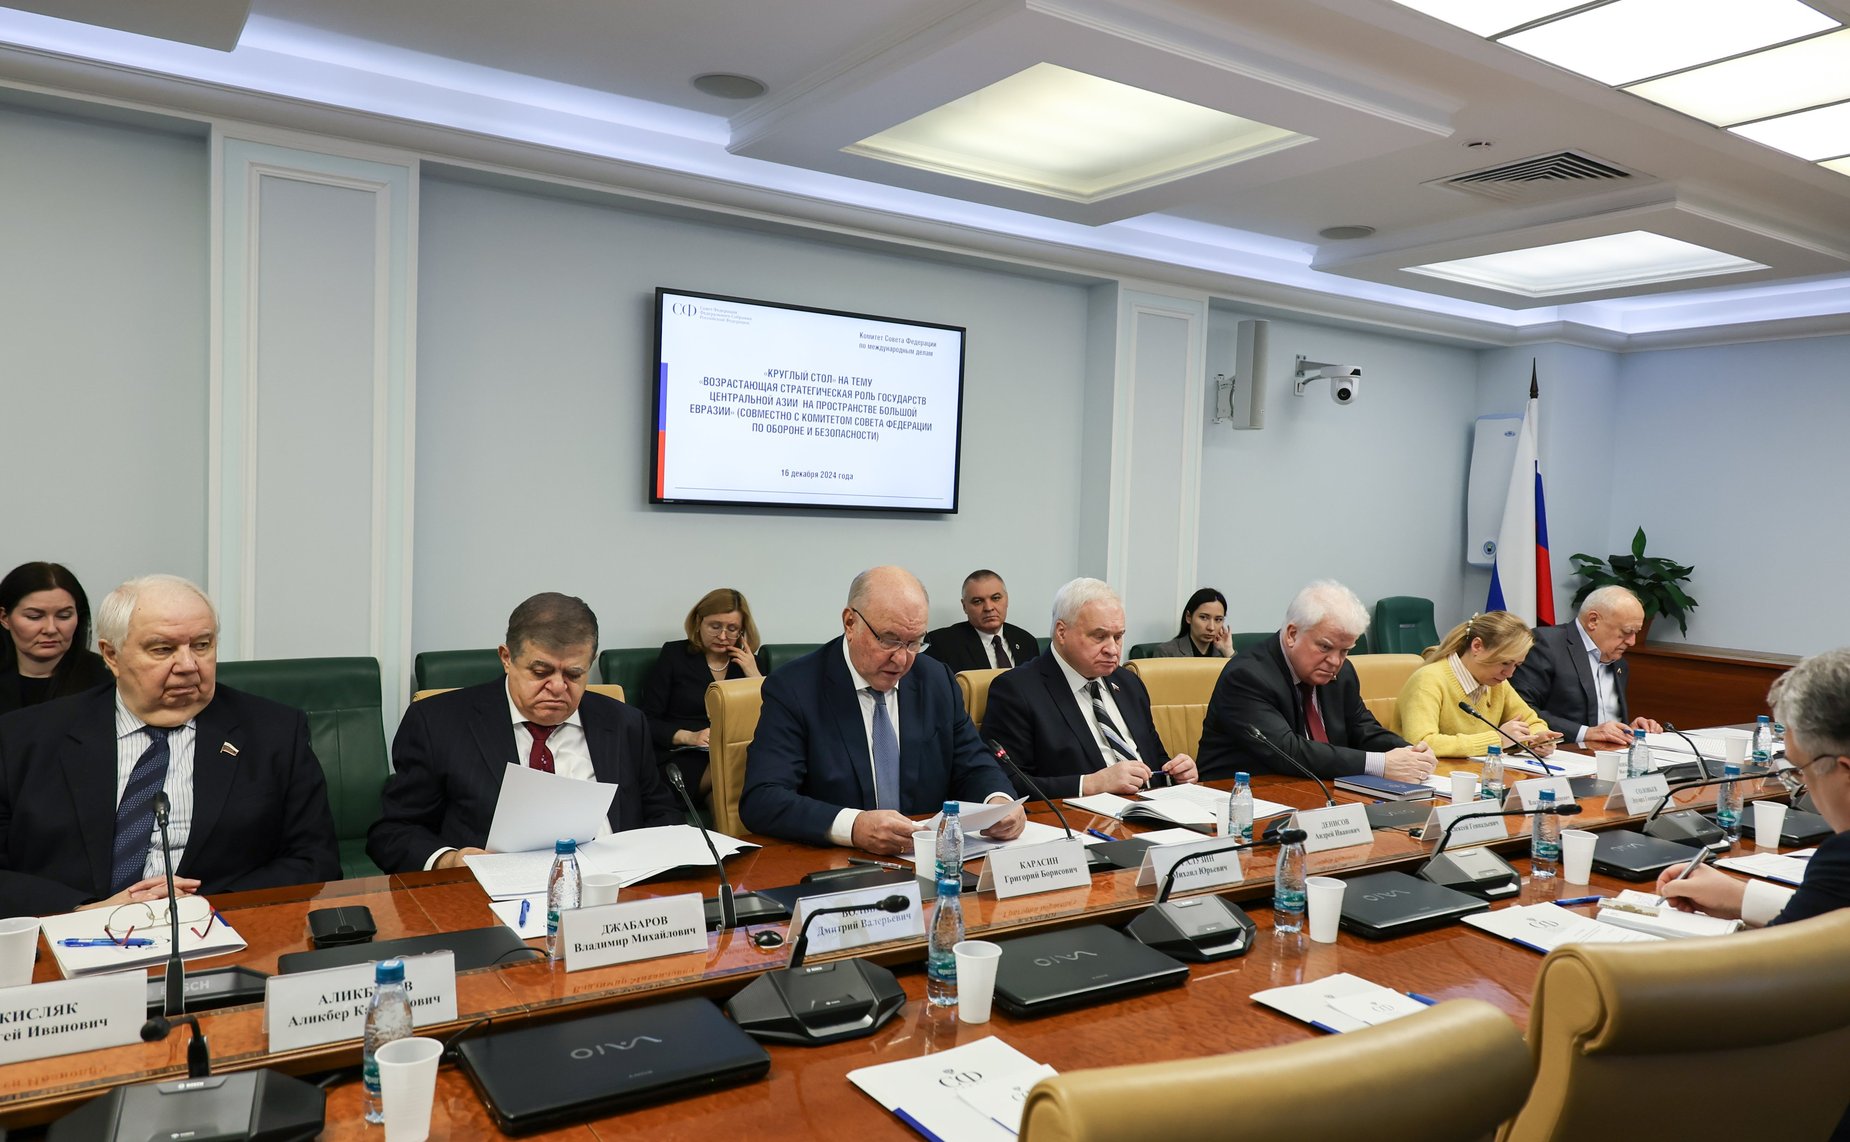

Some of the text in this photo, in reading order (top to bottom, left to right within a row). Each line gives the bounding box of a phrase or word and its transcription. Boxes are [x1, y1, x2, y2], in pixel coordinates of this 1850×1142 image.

[672, 302, 697, 317] СФ
[860, 332, 937, 348] Комитет Совета Федерации
[868, 344, 914, 354] международным
[838, 376, 849, 385] НА
[851, 376, 872, 388] ТЕМУ
[780, 383, 853, 398] СТРАТЕГИЧЕСКАЯ
[854, 390, 876, 401] РОЛЬ
[877, 392, 927, 406] ГОСУДАРСТВ
[710, 391, 918, 418] ЦЕНТРАЛЬНОЙ АЗИИ НА ПРОСТРАНСТВЕ БОЛЬШОЙ
[736, 408, 792, 421] (СОВМЕСТНО
[794, 412, 800, 422] С
[802, 412, 852, 425] КОМИТЕТОМ
[854, 416, 884, 428] СОВЕТА
[886, 420, 933, 432] ФЕДЕРАЦИИ
[752, 422, 880, 442] ПО ОБОРОНЕ И БЕЗОПАСНОСТИ)
[781, 469, 790, 477] 16
[790, 470, 818, 480] декабря
[820, 470, 837, 479] 2024
[1322, 818, 1350, 830] ДЕНИСОВ
[1019, 856, 1060, 870] КАРАСИН
[1198, 864, 1228, 876] Юрьевич
[1004, 866, 1078, 884] Григорий Борисович
[601, 916, 668, 936] ДЖАБАРОВ
[816, 921, 859, 937] Дмитрий
[860, 912, 912, 928] Валерьевич
[574, 927, 697, 953] Владимир Михайлович
[1034, 950, 1098, 967] VAIO
[160, 979, 210, 995] BSCH
[318, 980, 413, 1006] АЛИКБВ
[288, 1008, 350, 1028] Аликбер
[28, 1018, 109, 1039] Иванович
[570, 1036, 663, 1060] VAIO
